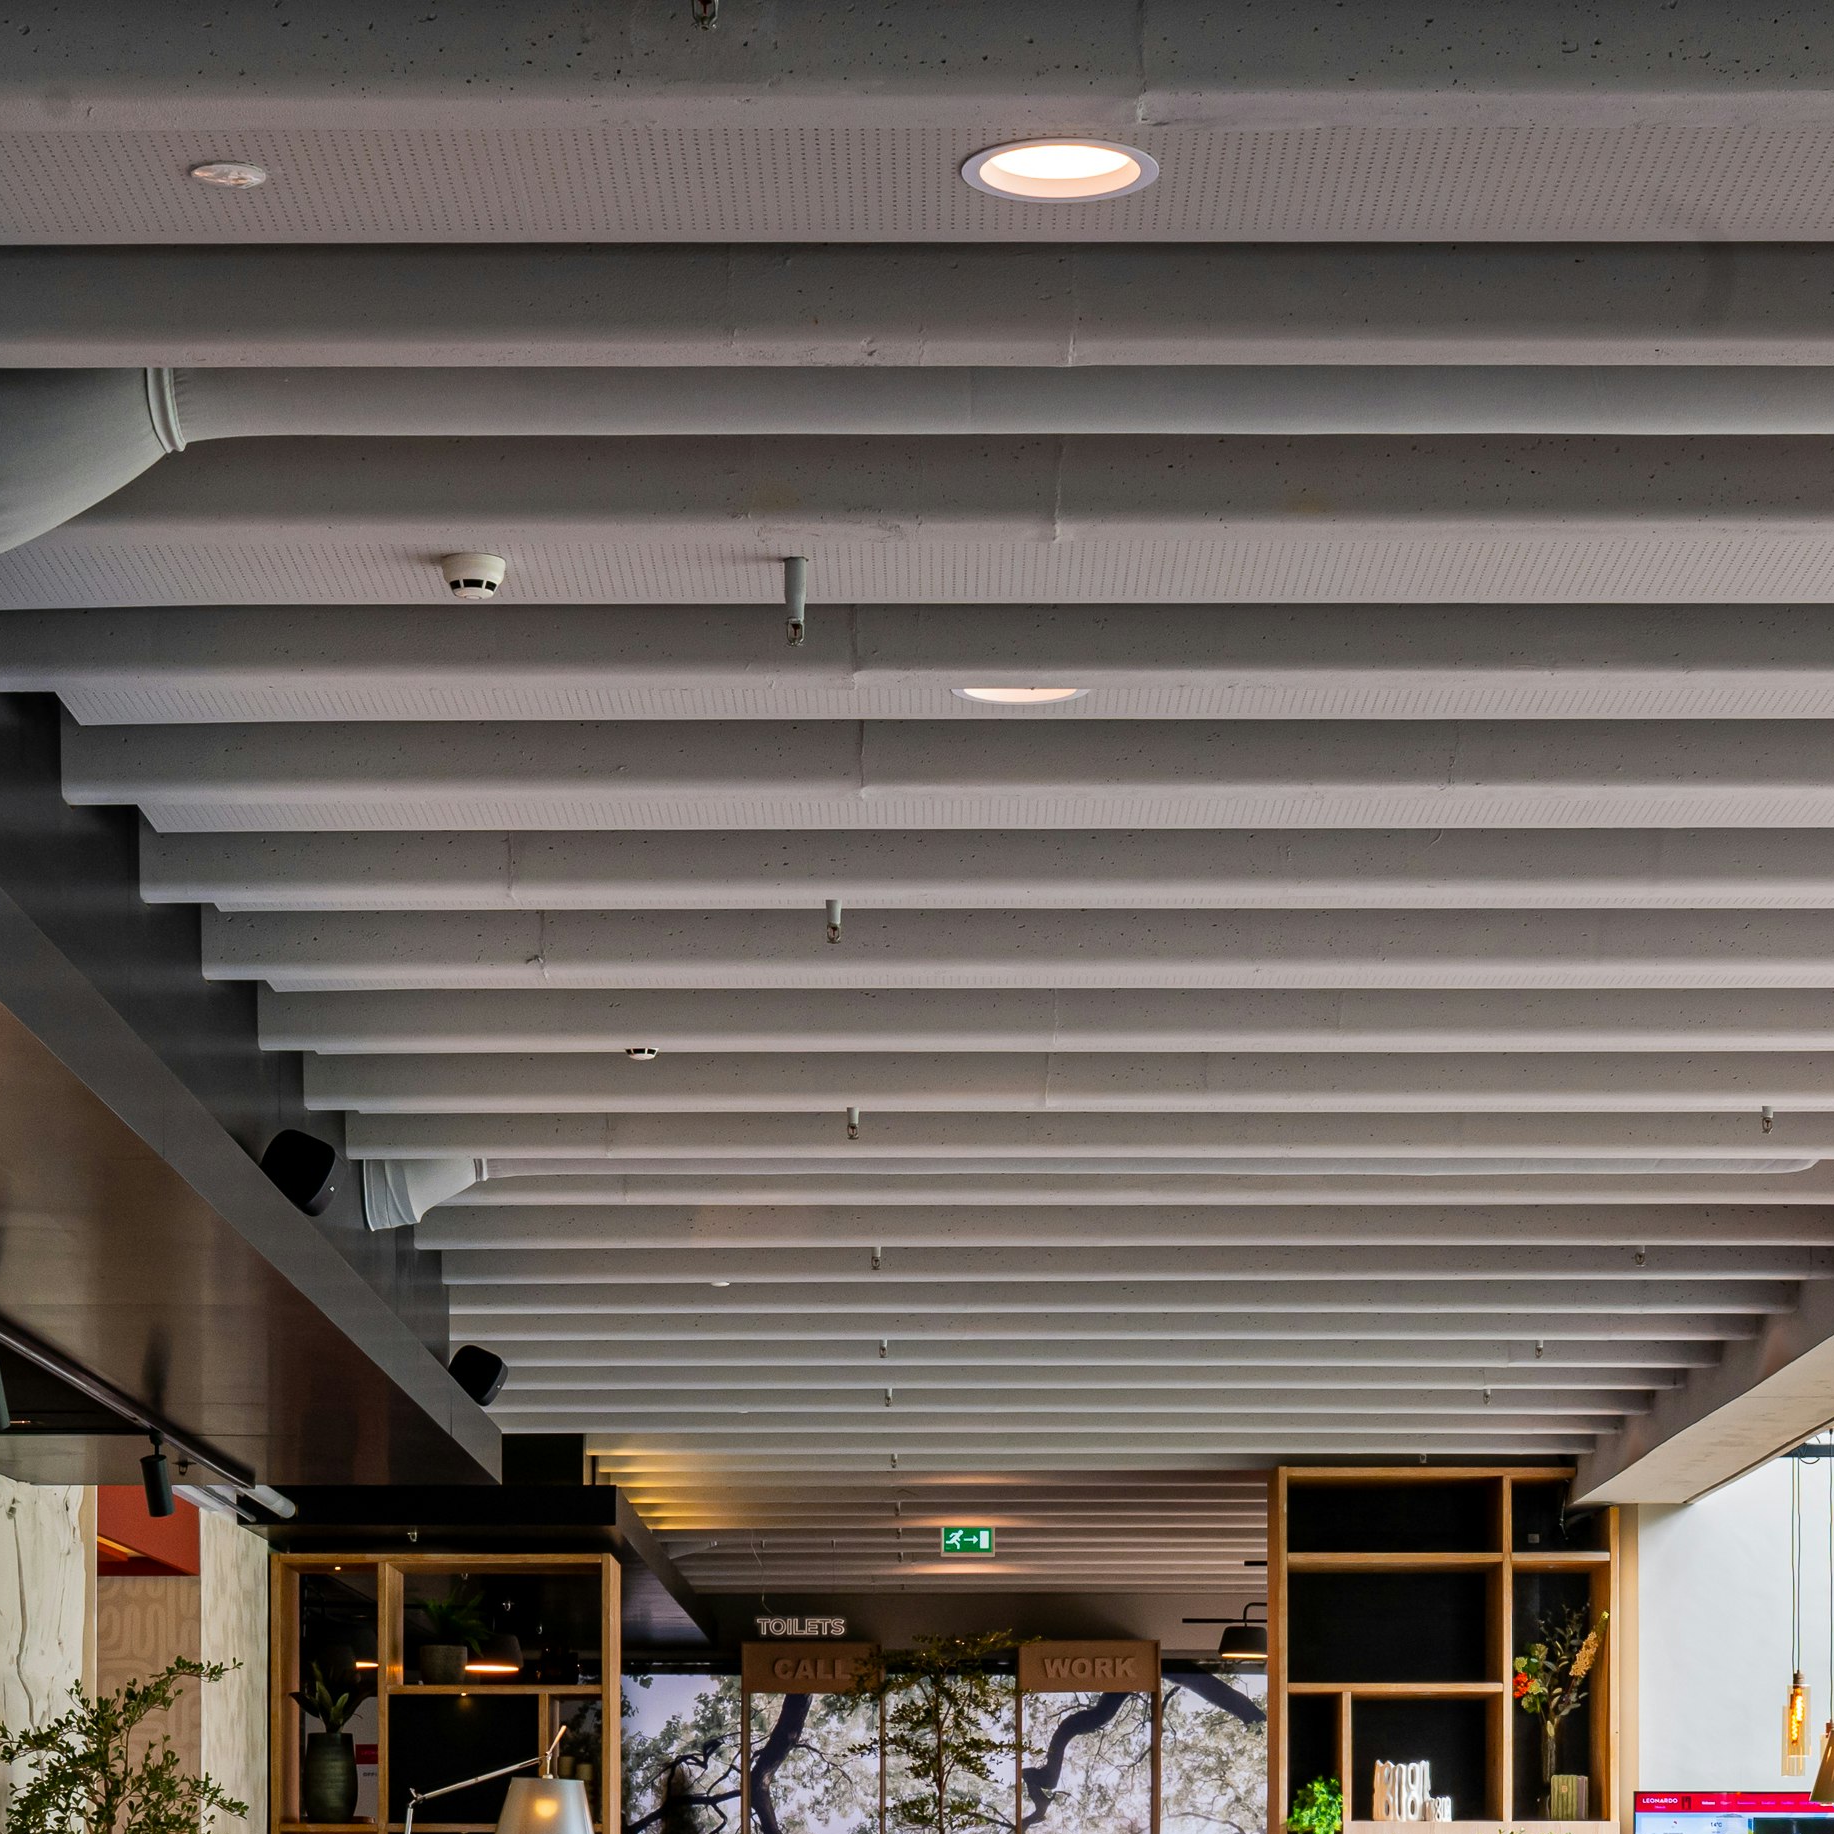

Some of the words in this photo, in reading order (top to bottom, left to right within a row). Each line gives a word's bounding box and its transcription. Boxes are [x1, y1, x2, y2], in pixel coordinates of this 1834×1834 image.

[755, 1616, 846, 1637] TOILETS
[772, 1656, 853, 1681] CALL
[1042, 1655, 1137, 1680] WORK
